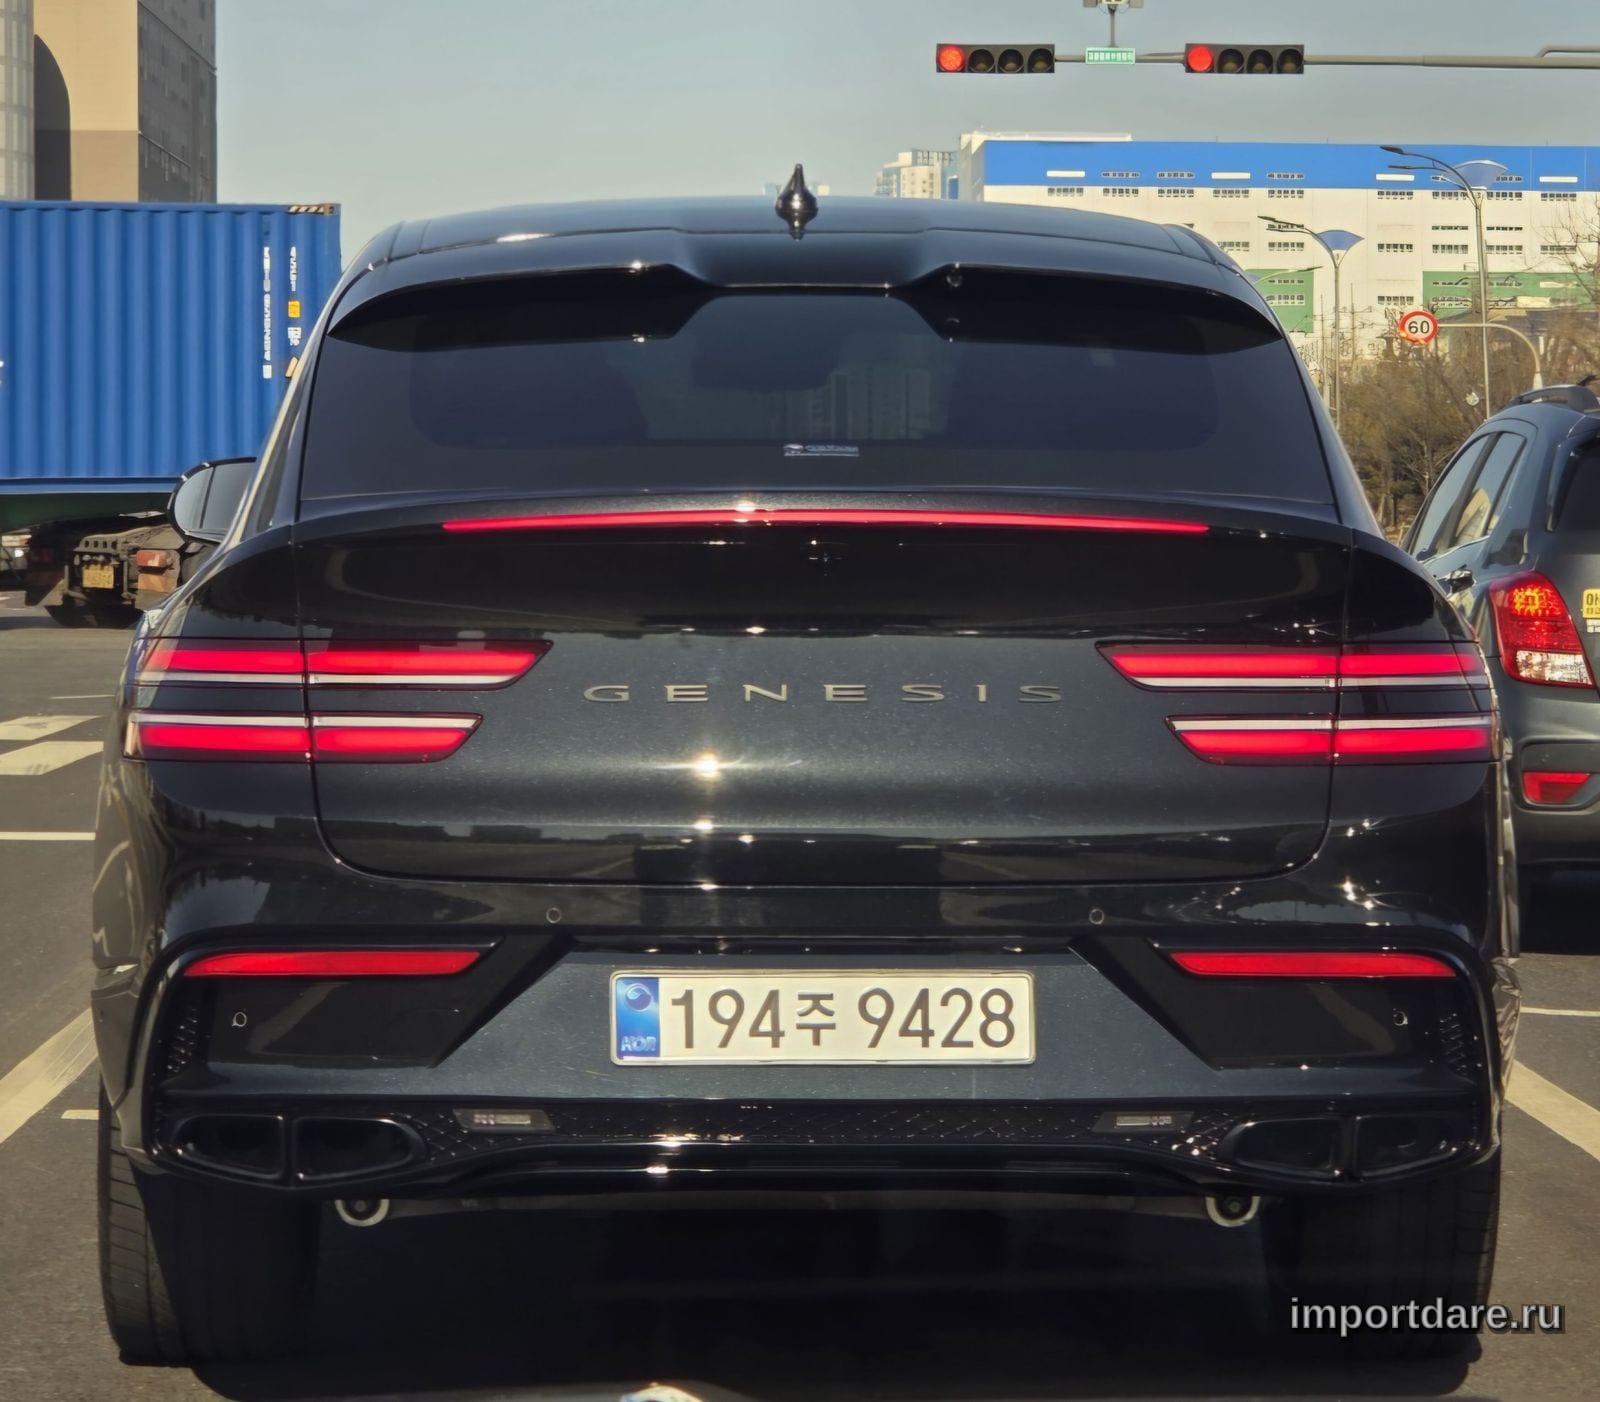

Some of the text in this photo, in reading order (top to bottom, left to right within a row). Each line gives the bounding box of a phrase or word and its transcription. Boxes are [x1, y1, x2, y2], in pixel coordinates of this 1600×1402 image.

[1408, 320, 1430, 334] 60
[583, 684, 1062, 703] GENESIS
[671, 986, 1015, 1049] 194주 9428
